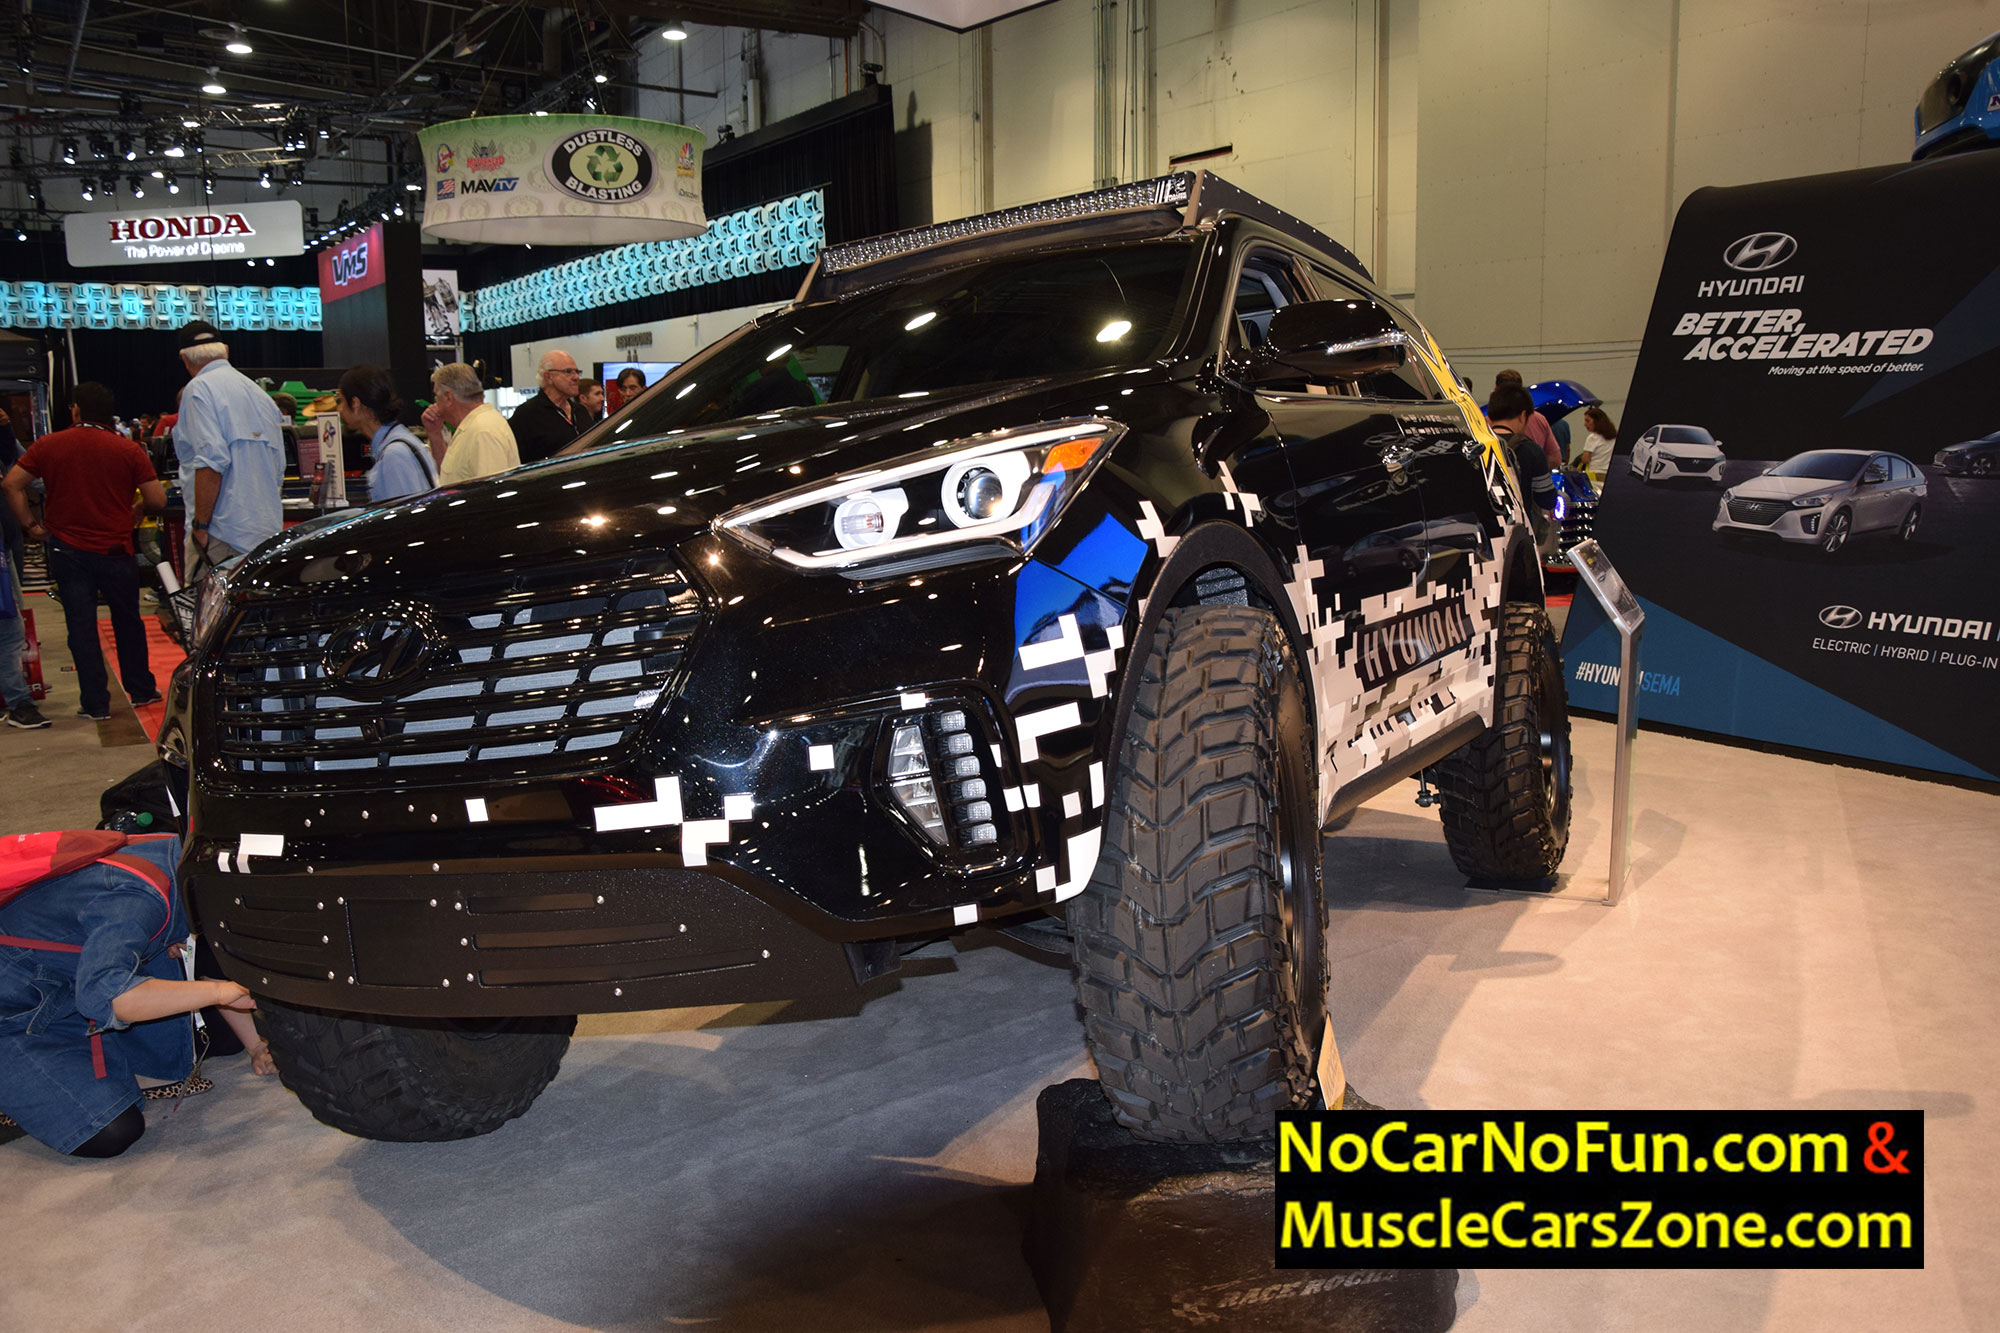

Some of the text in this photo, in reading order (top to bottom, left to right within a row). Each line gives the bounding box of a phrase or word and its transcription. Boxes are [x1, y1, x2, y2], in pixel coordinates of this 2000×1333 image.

[563, 131, 643, 157] DUSTLESS
[461, 177, 519, 195] MAVTV
[565, 176, 643, 200] BLASTING
[108, 213, 255, 243] HONDA
[124, 246, 147, 259] The
[149, 244, 185, 257] Power
[186, 242, 199, 255] of
[332, 243, 368, 285] VMS
[1697, 275, 1805, 297] HYUNDAI
[1672, 308, 1806, 337] BETTER,
[1683, 328, 1934, 361] ACCELERATED
[1768, 362, 1924, 376] Moving at the speed of better.
[1867, 611, 1992, 641] HYUNDAI
[1363, 603, 1467, 681] HYUNDAI
[1812, 637, 1999, 669] ELECTRIC HYBRID PLUG-IN
[1575, 661, 1681, 697] #HYUNISEMA
[1216, 1281, 1300, 1309] RACE
